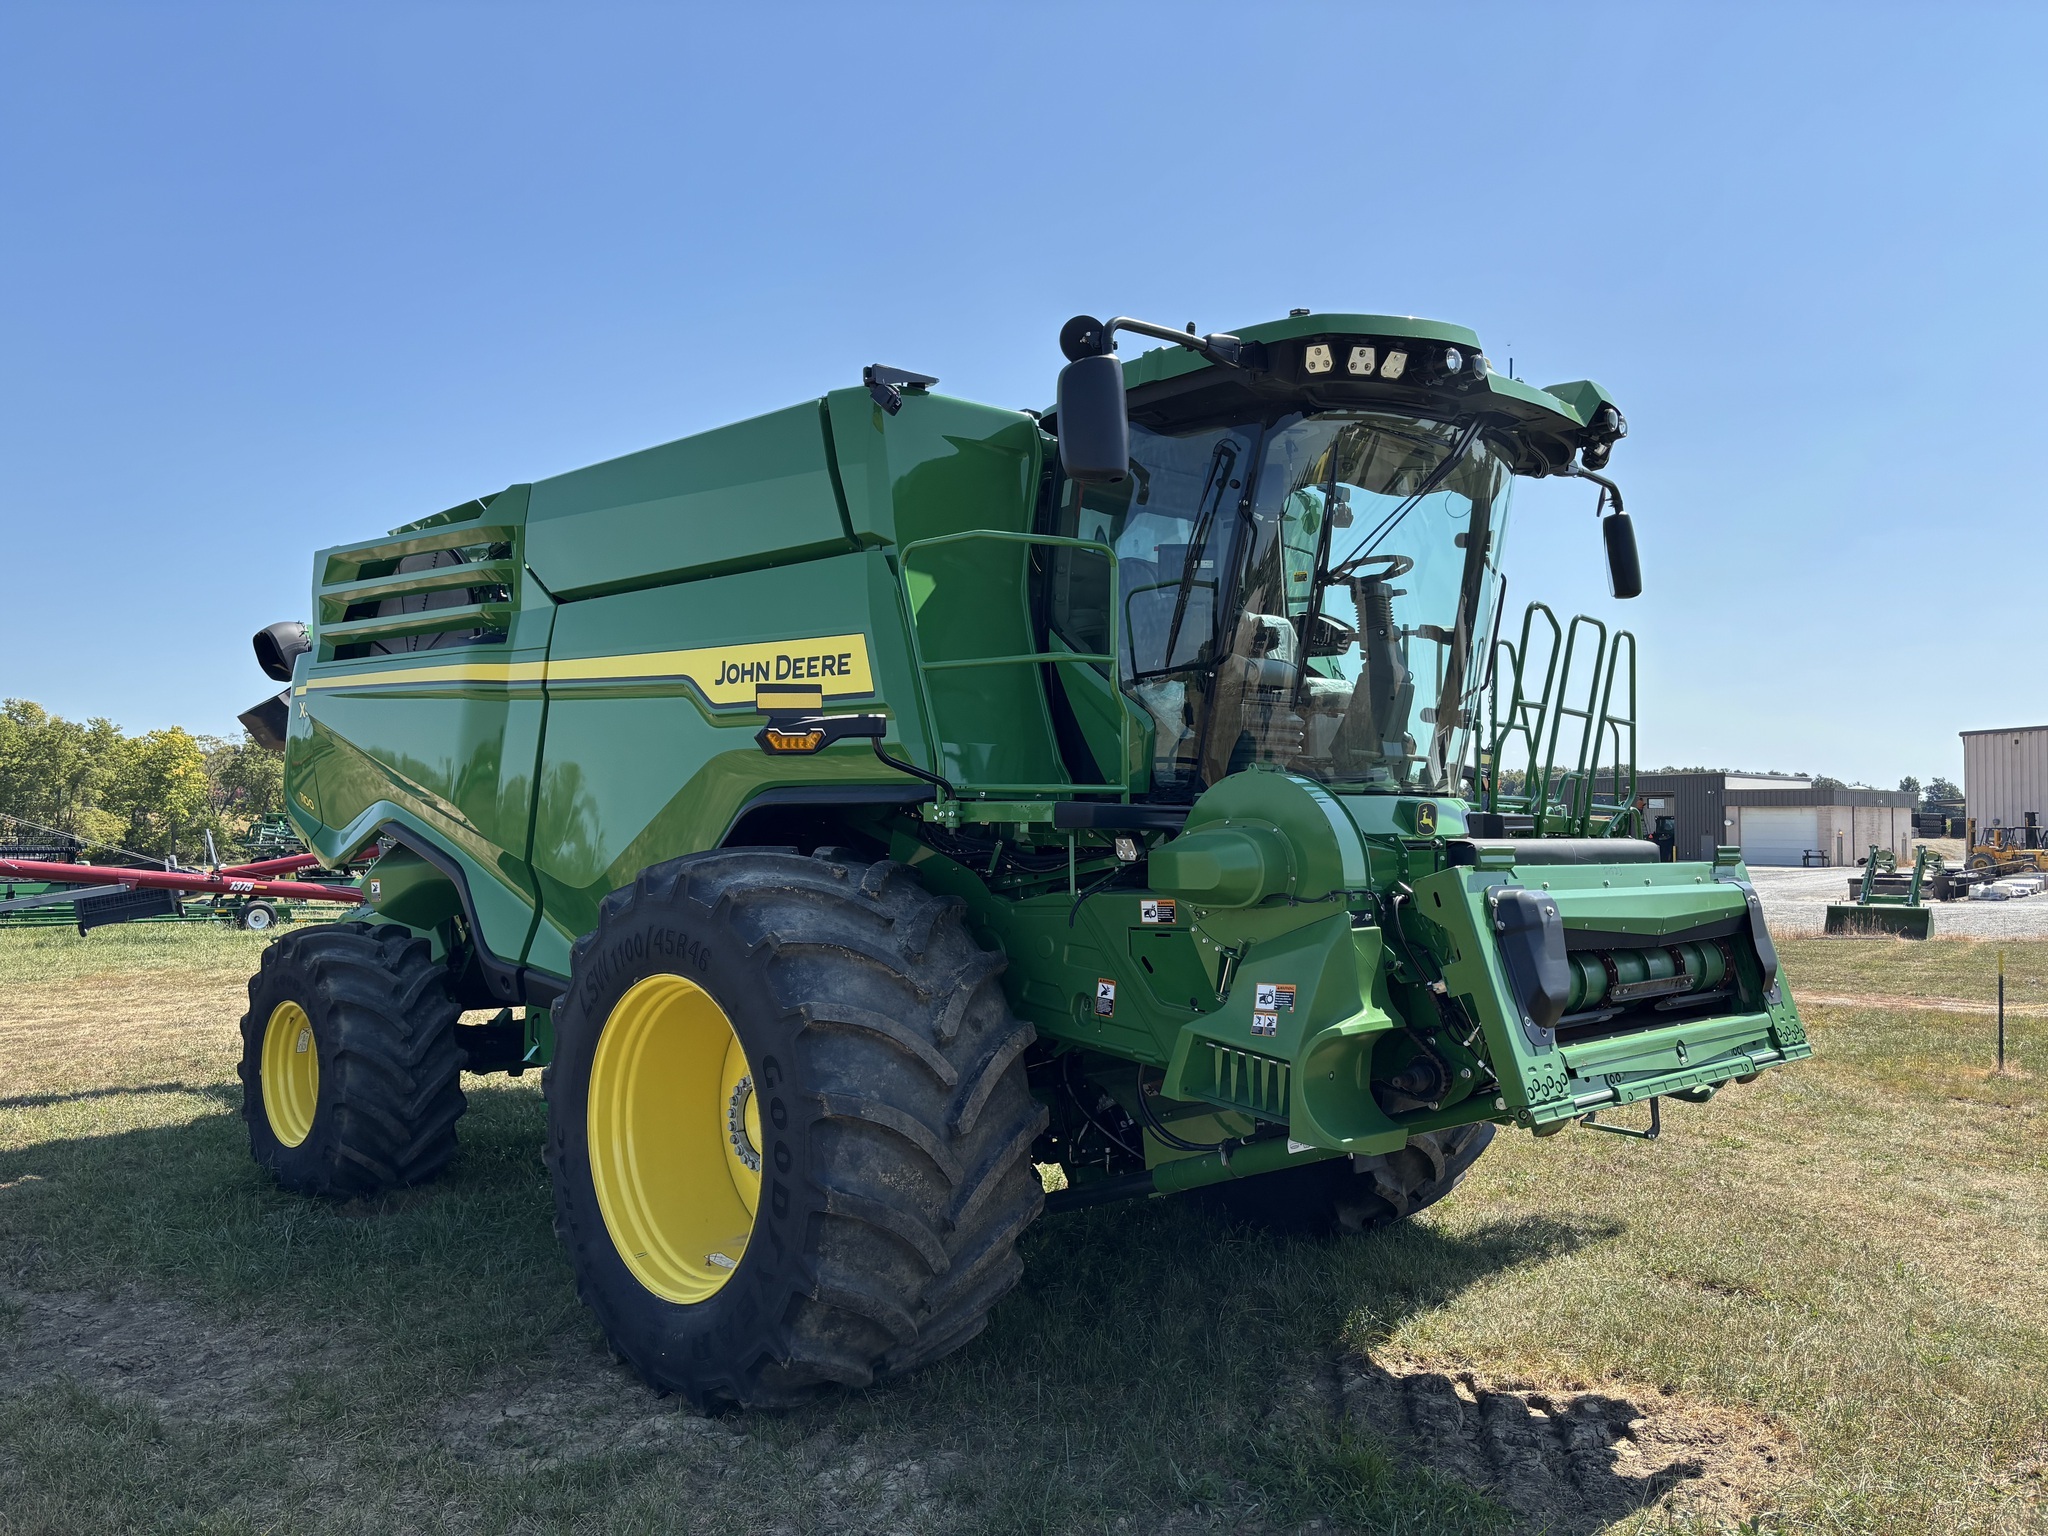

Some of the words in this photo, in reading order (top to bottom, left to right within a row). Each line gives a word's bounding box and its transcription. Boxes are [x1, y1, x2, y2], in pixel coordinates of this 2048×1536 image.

[714, 660, 770, 685] JOHN
[775, 653, 852, 680] DEERE
[229, 881, 254, 892] 1375
